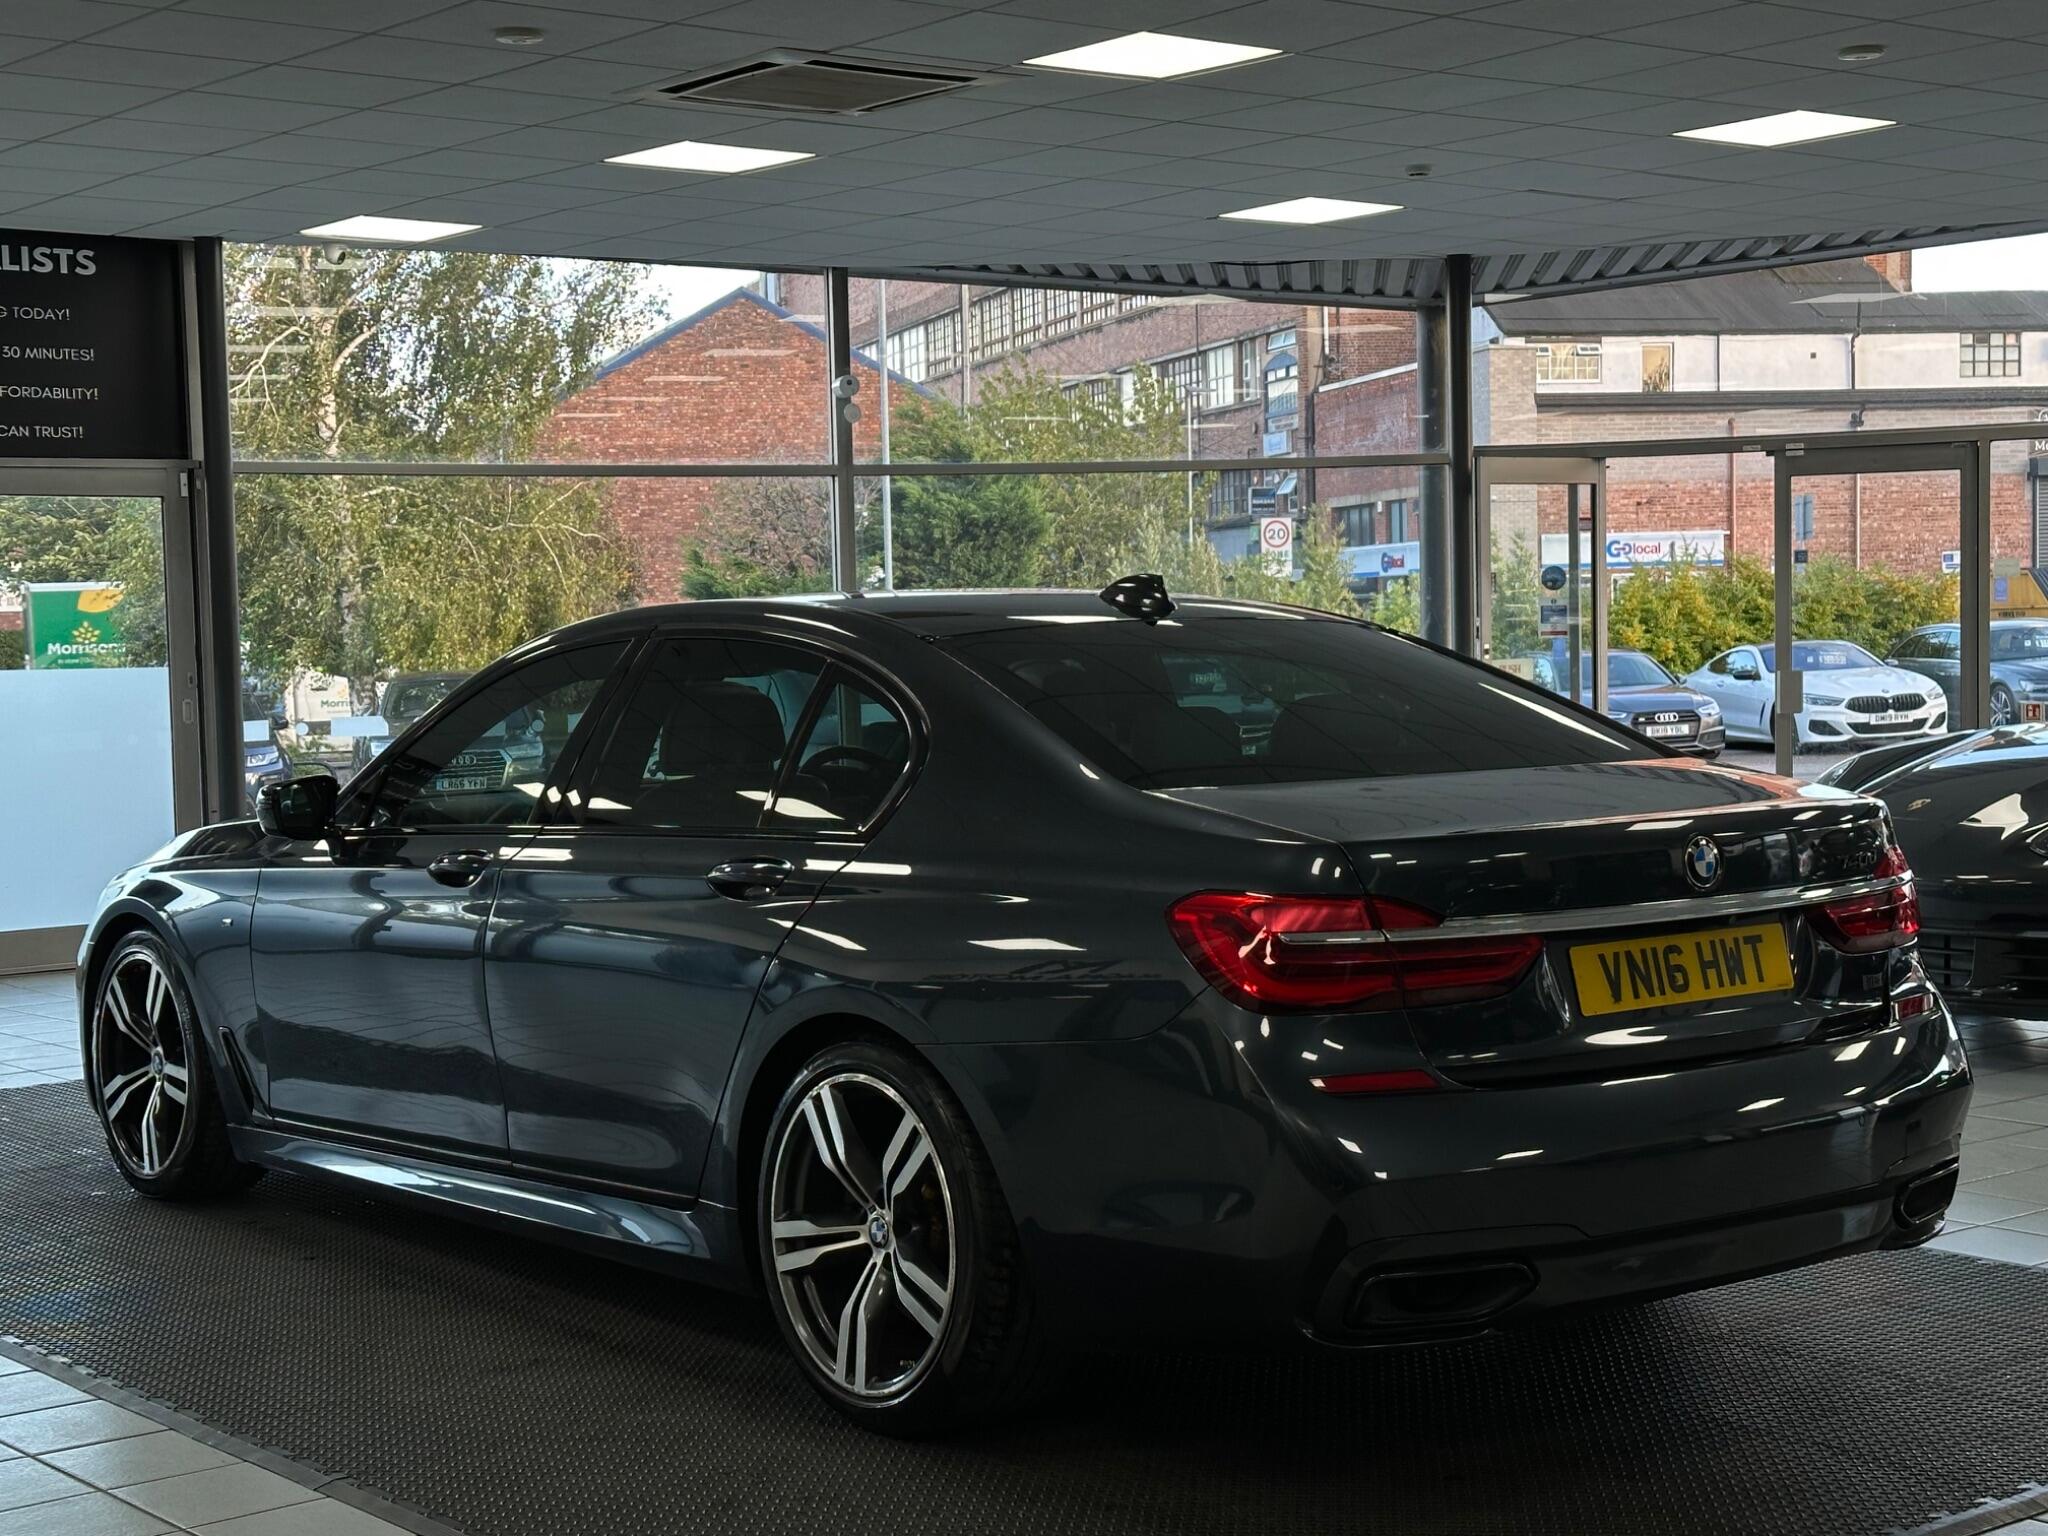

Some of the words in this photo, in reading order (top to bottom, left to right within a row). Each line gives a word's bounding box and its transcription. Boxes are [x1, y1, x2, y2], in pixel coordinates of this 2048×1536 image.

[0, 245, 97, 276] LISTS
[12, 306, 70, 321] TODAY!
[2, 346, 20, 359] 30
[25, 347, 95, 362] MINUTES!
[0, 385, 99, 400] FORDABILITY!
[0, 425, 30, 437] CAN
[33, 426, 84, 439] TRUST!
[1267, 528, 1286, 540] 20
[1597, 944, 1690, 1005] VN16
[1695, 933, 1765, 991] HWT
